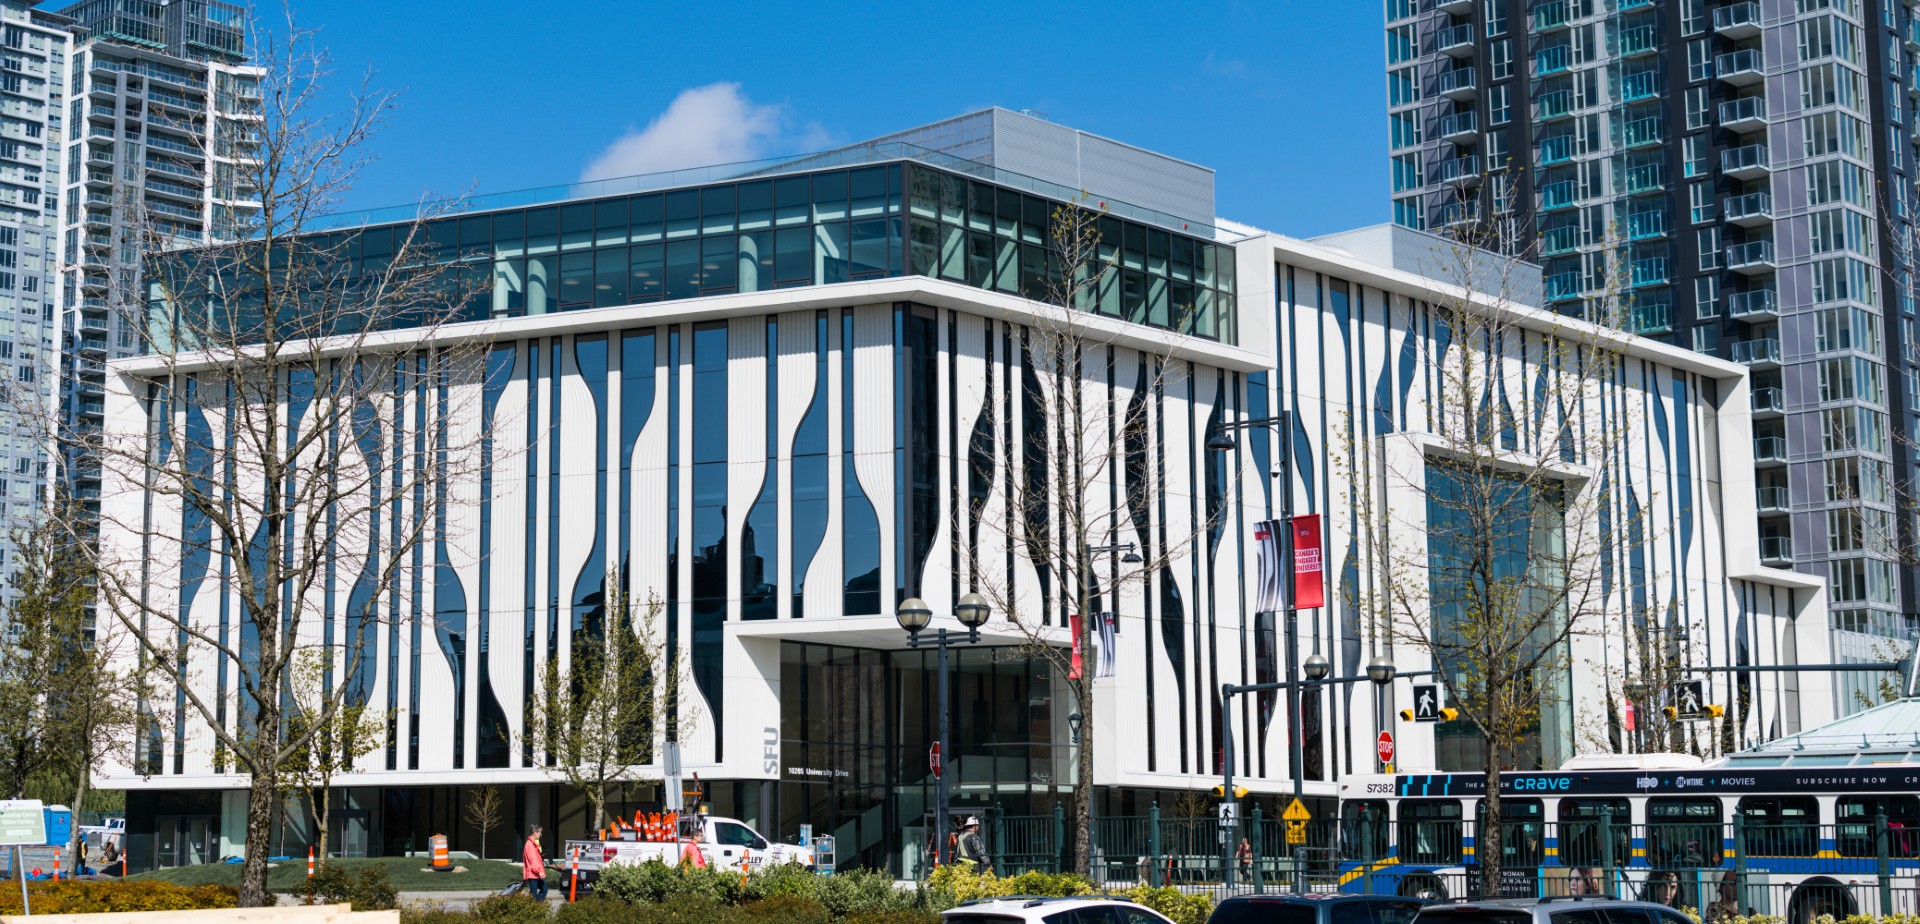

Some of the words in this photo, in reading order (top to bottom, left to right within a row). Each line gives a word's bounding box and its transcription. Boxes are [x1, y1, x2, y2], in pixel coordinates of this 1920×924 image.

[1294, 548, 1319, 557] CANADA'S
[1295, 556, 1318, 564] ENGAGED
[763, 726, 779, 776] SFU
[1379, 740, 1394, 754] STOP
[788, 767, 805, 775] 10285
[805, 767, 833, 778] University
[835, 769, 849, 777] Drive
[1636, 777, 1659, 788] HBO
[1721, 777, 1756, 786] MOVIES
[1796, 777, 1857, 785] SUBSCRIBE
[1366, 783, 1395, 794] S7382
[739, 856, 764, 864] VLLEY
